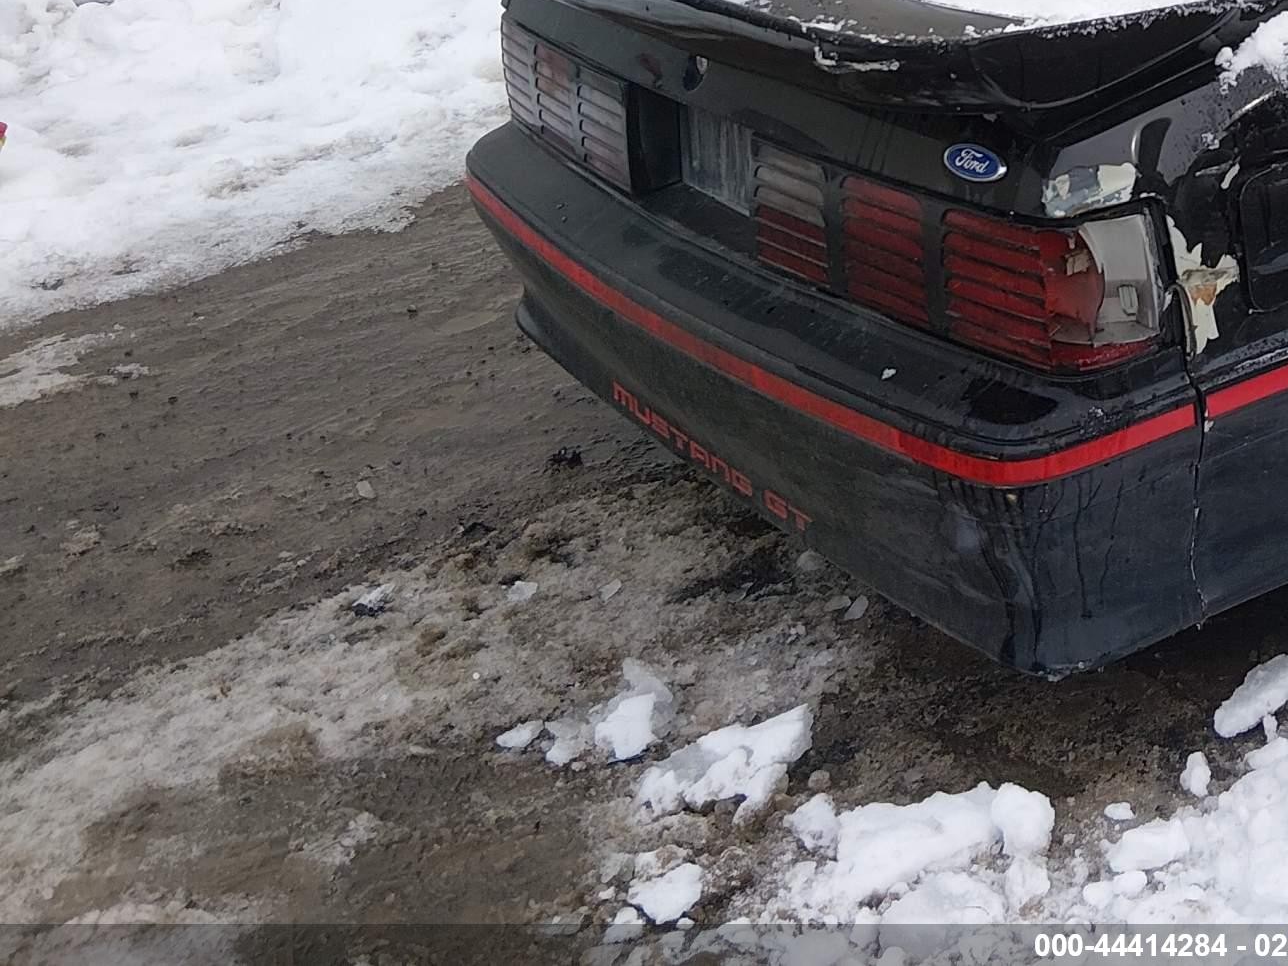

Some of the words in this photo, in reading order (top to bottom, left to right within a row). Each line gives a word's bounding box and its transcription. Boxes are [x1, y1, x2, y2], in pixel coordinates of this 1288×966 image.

[954, 148, 990, 174] Ford
[612, 380, 753, 498] MUSTANG
[763, 489, 814, 532] GT
